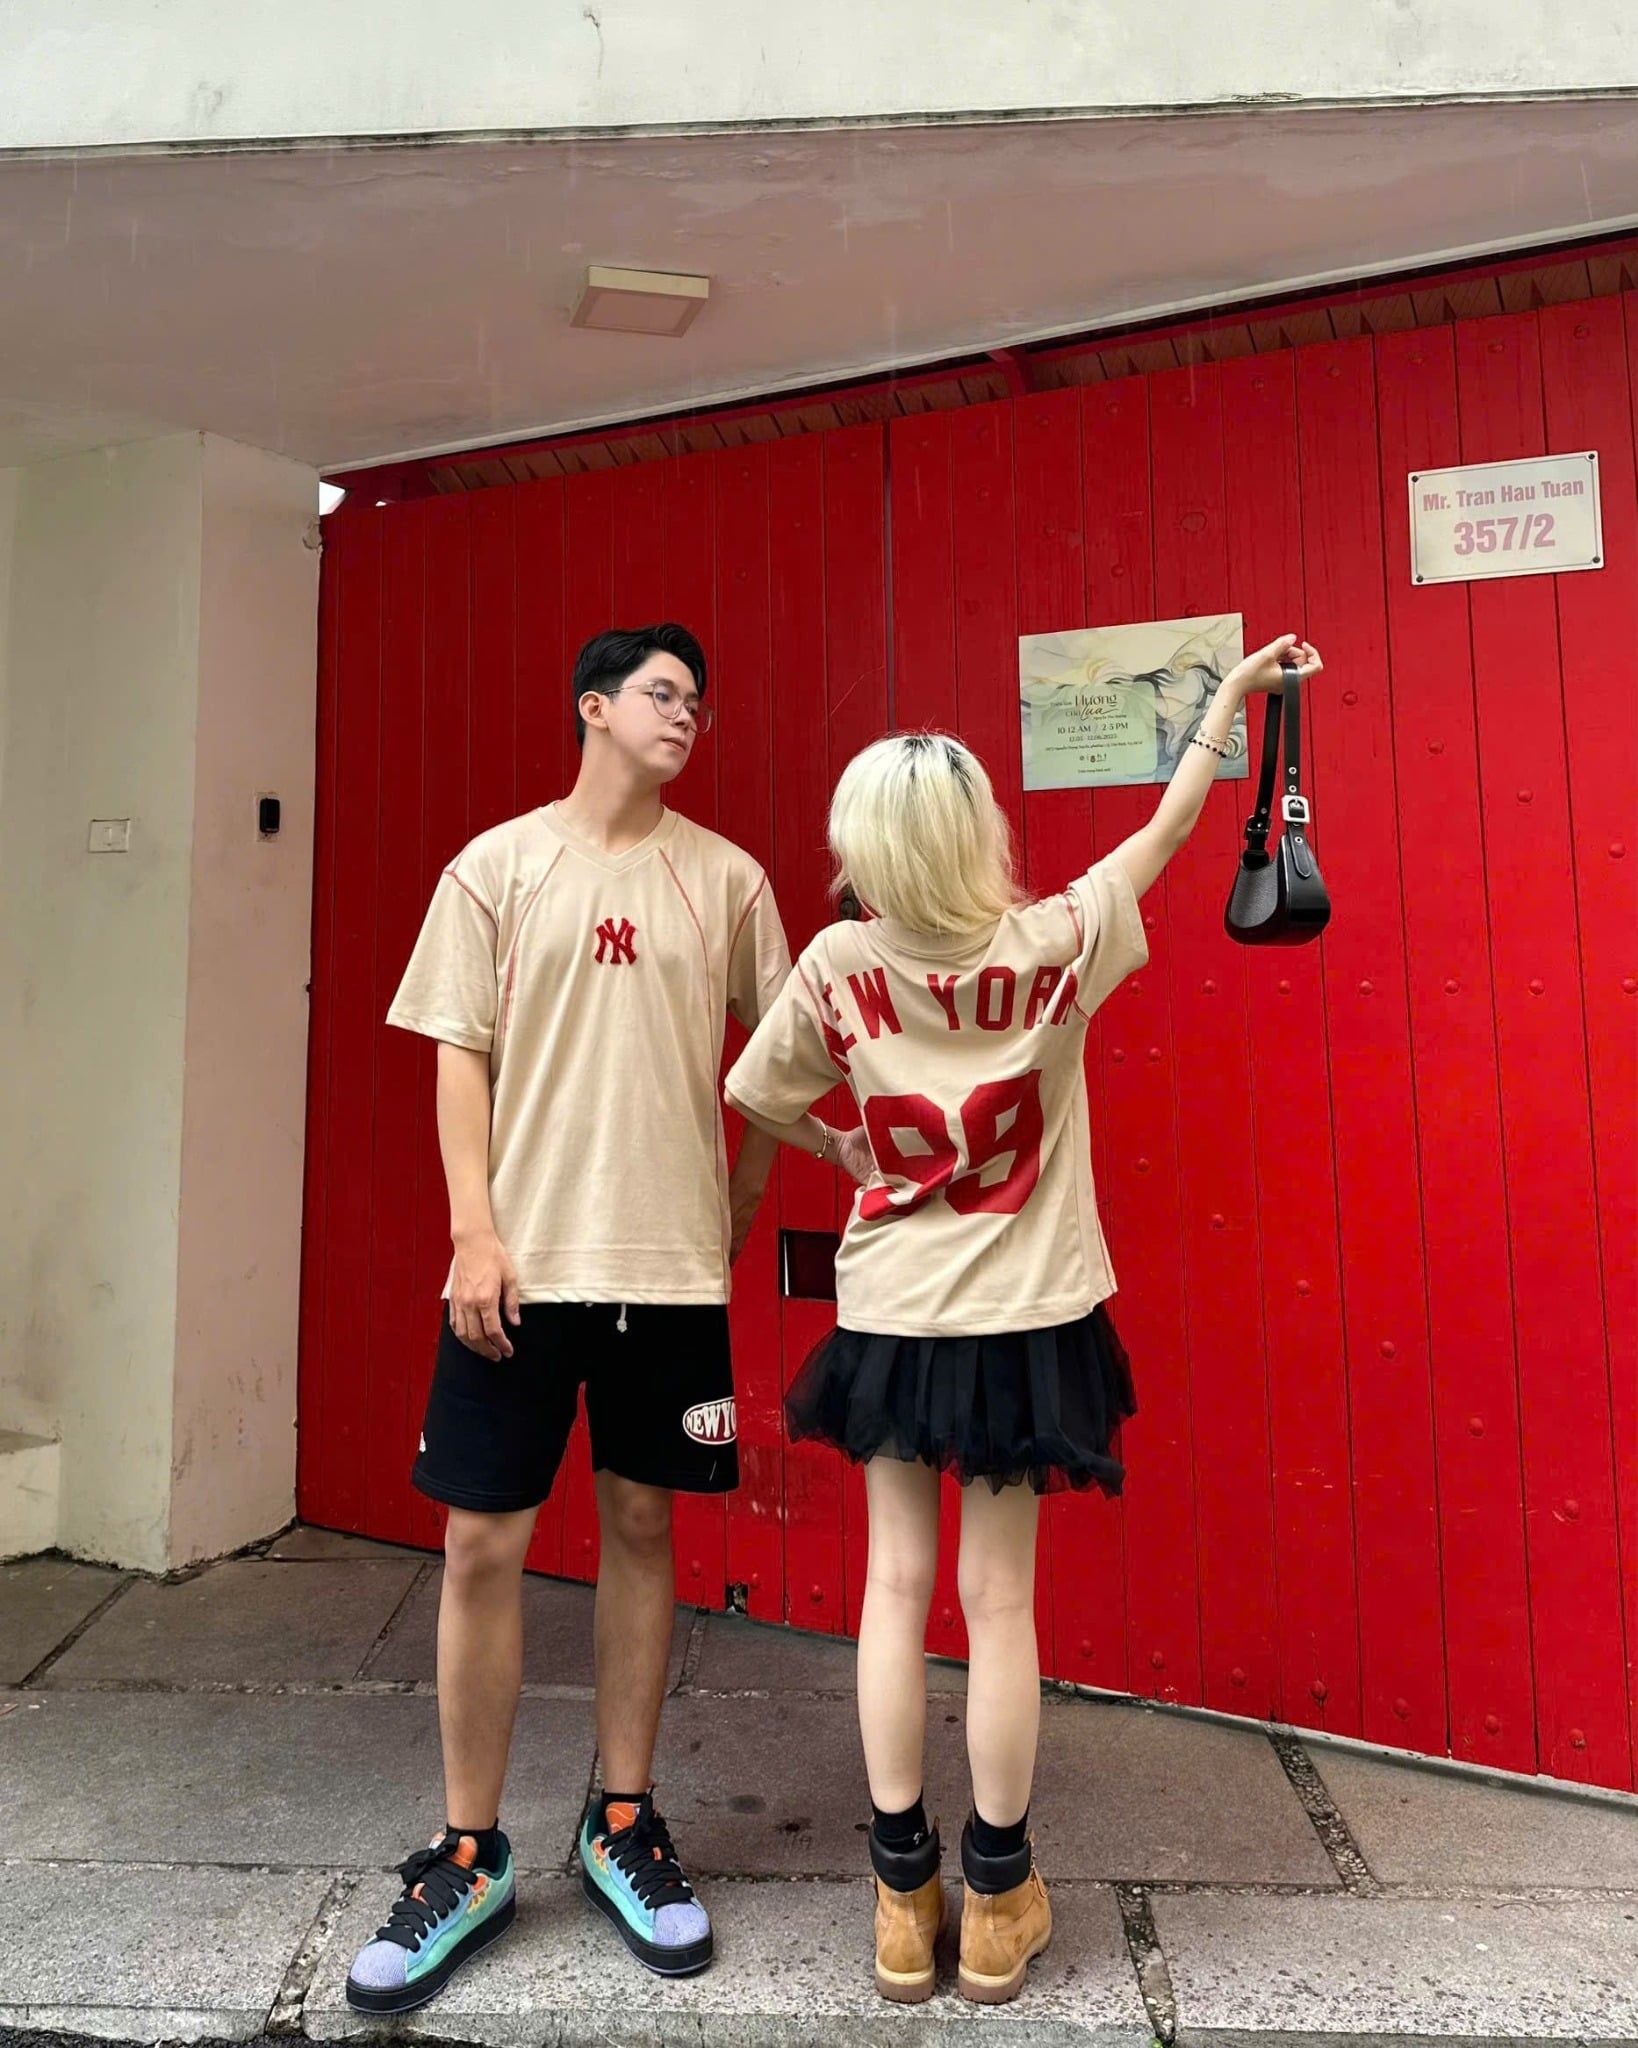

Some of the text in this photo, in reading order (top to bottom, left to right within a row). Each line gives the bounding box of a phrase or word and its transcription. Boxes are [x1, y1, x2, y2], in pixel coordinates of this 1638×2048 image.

[1423, 480, 1584, 511] Mr. Tran Hau Tuan
[1454, 513, 1556, 556] 357/2
[1115, 721, 1128, 730] PM
[594, 917, 637, 966] NY
[859, 1069, 1045, 1221] 99
